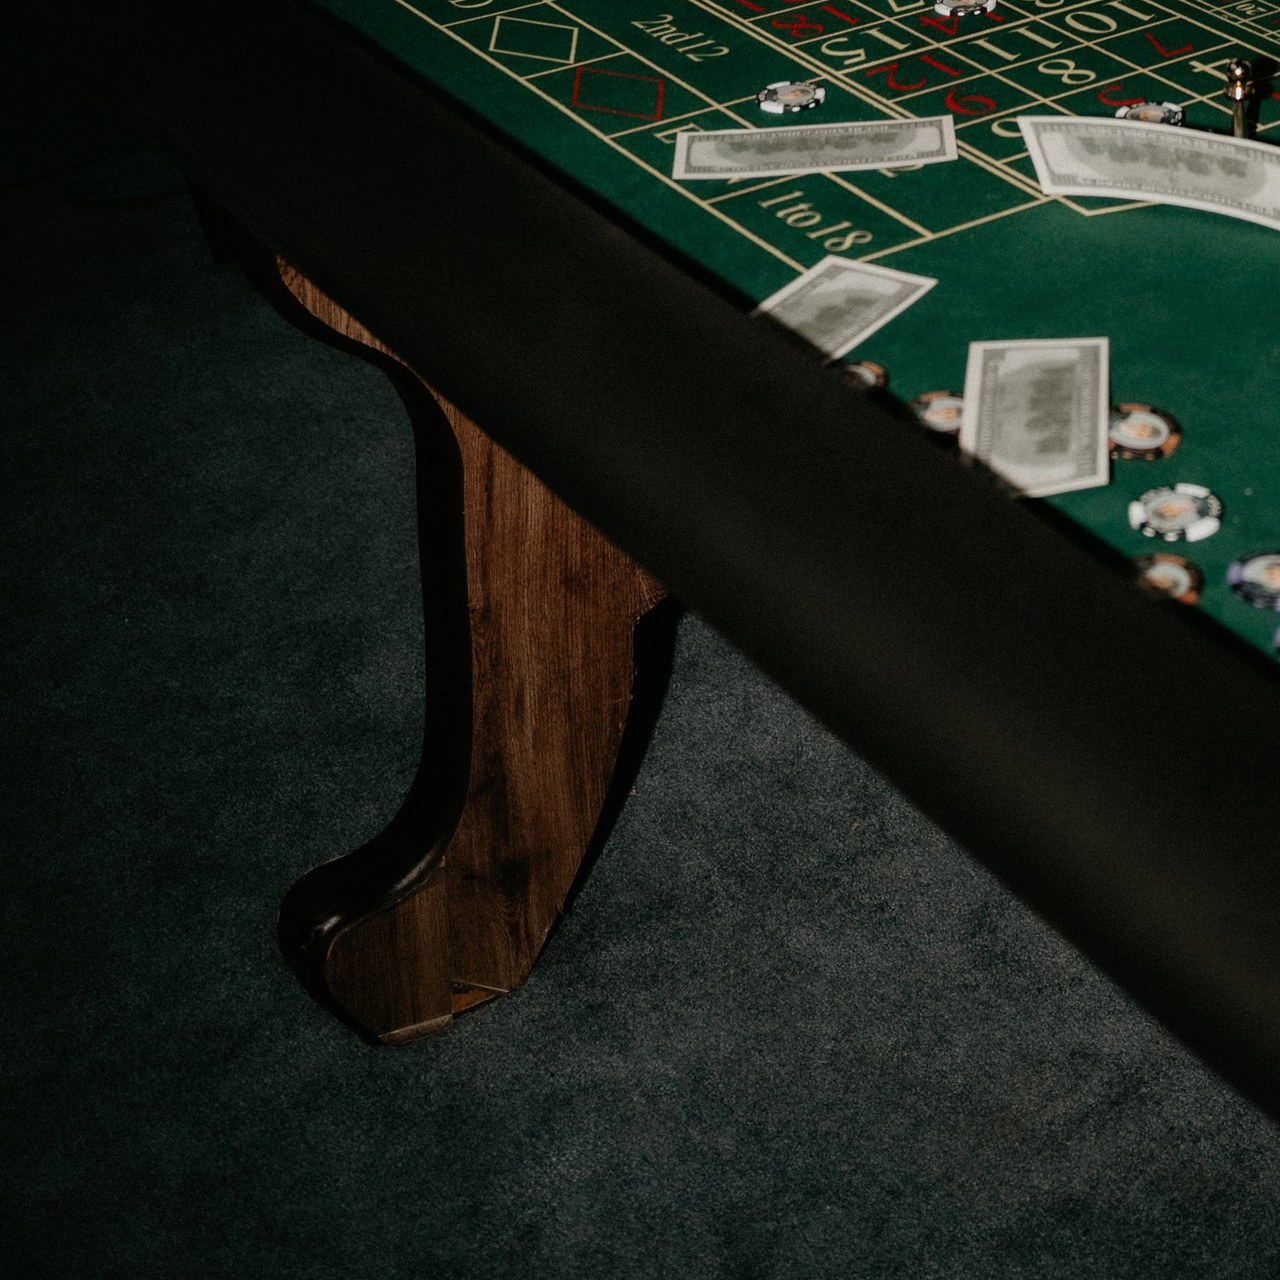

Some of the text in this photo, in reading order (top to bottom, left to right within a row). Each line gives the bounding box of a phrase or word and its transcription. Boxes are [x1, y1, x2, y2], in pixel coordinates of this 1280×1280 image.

[770, 4, 861, 37] 18
[820, 27, 912, 66] 15
[966, 25, 1063, 62] 11
[1144, 31, 1195, 57] 7
[865, 54, 965, 91] 12
[1037, 58, 1097, 85] 8
[944, 87, 996, 115] 9
